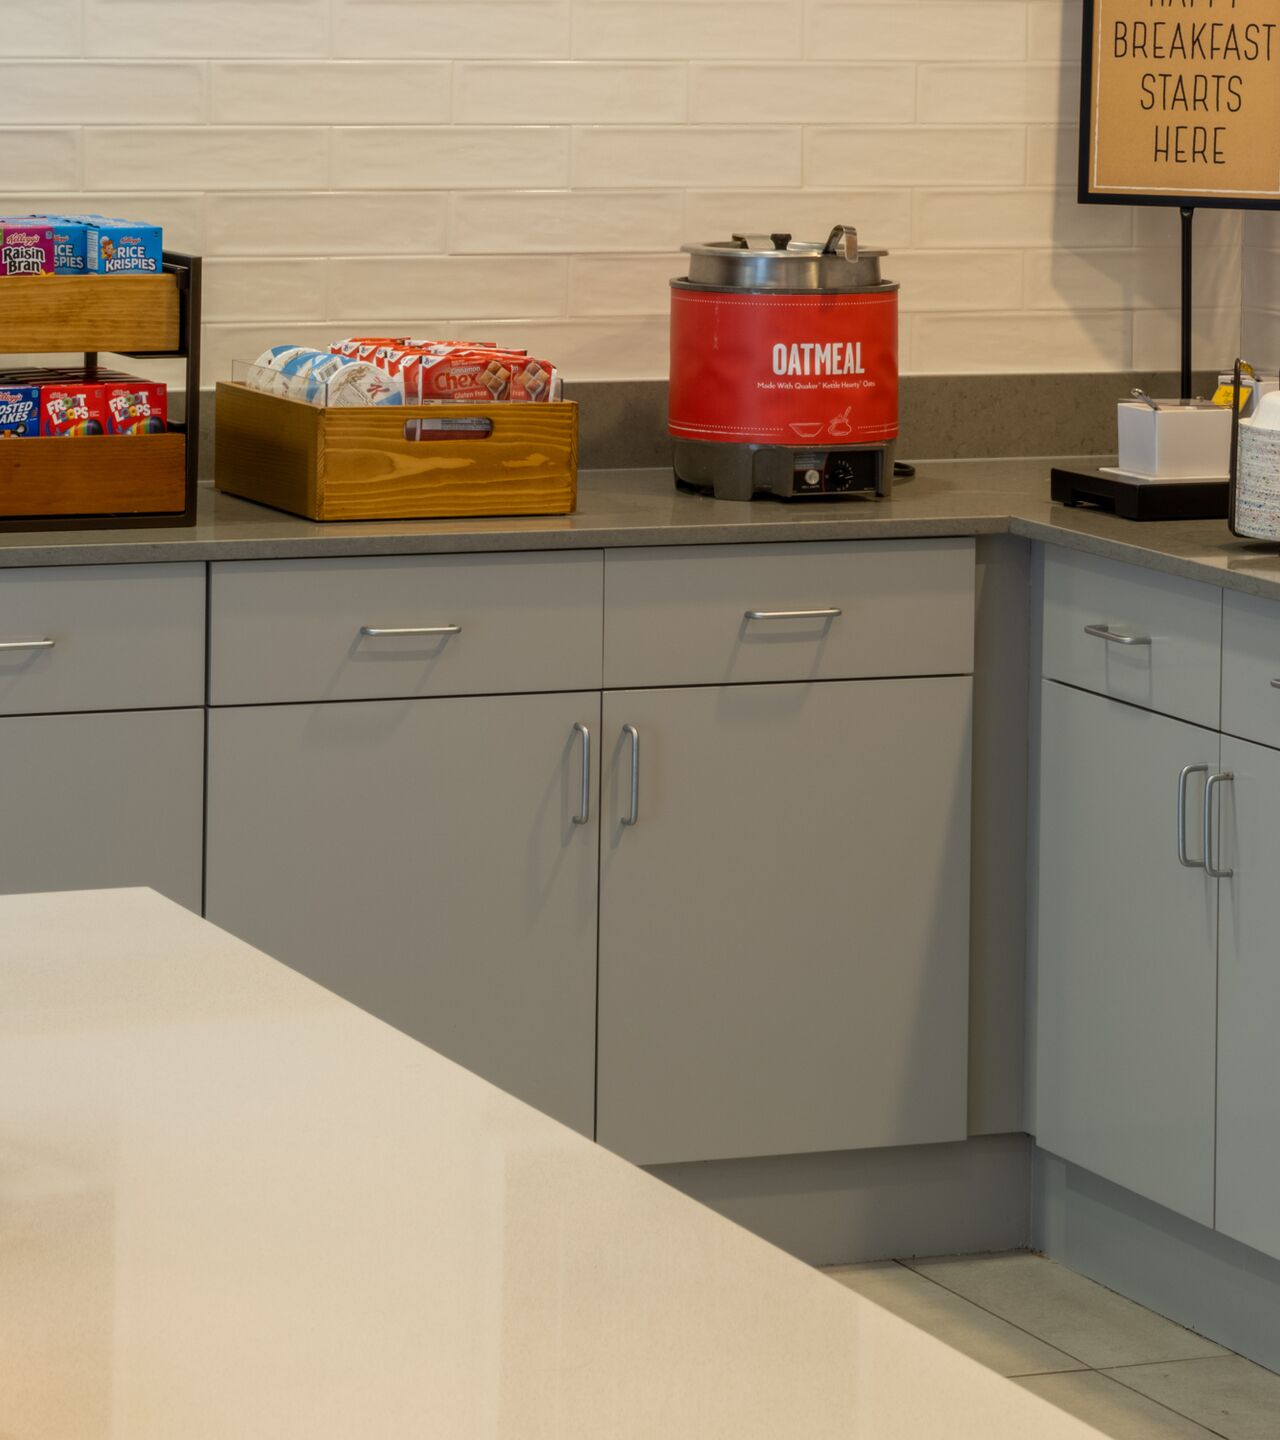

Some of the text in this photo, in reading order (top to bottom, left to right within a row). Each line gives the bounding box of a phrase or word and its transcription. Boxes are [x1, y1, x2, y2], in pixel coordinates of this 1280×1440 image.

[1114, 21, 1277, 61] BREAKFAST
[1140, 73, 1243, 112] STARTS
[1154, 125, 1226, 164] HERE
[2, 246, 45, 263] Raisin
[54, 244, 73, 256] ICE
[117, 246, 145, 258] RICE
[7, 259, 42, 276] Bran
[54, 257, 83, 268] SPIES
[105, 259, 156, 272] KRISPIES
[772, 341, 865, 376] OATMEAL
[434, 372, 478, 391] Chex
[108, 392, 148, 412] FROOT
[454, 391, 473, 399] Gluten
[46, 394, 86, 415] FROOT
[113, 404, 151, 422] LOOPS
[52, 407, 88, 425] LOOPS
